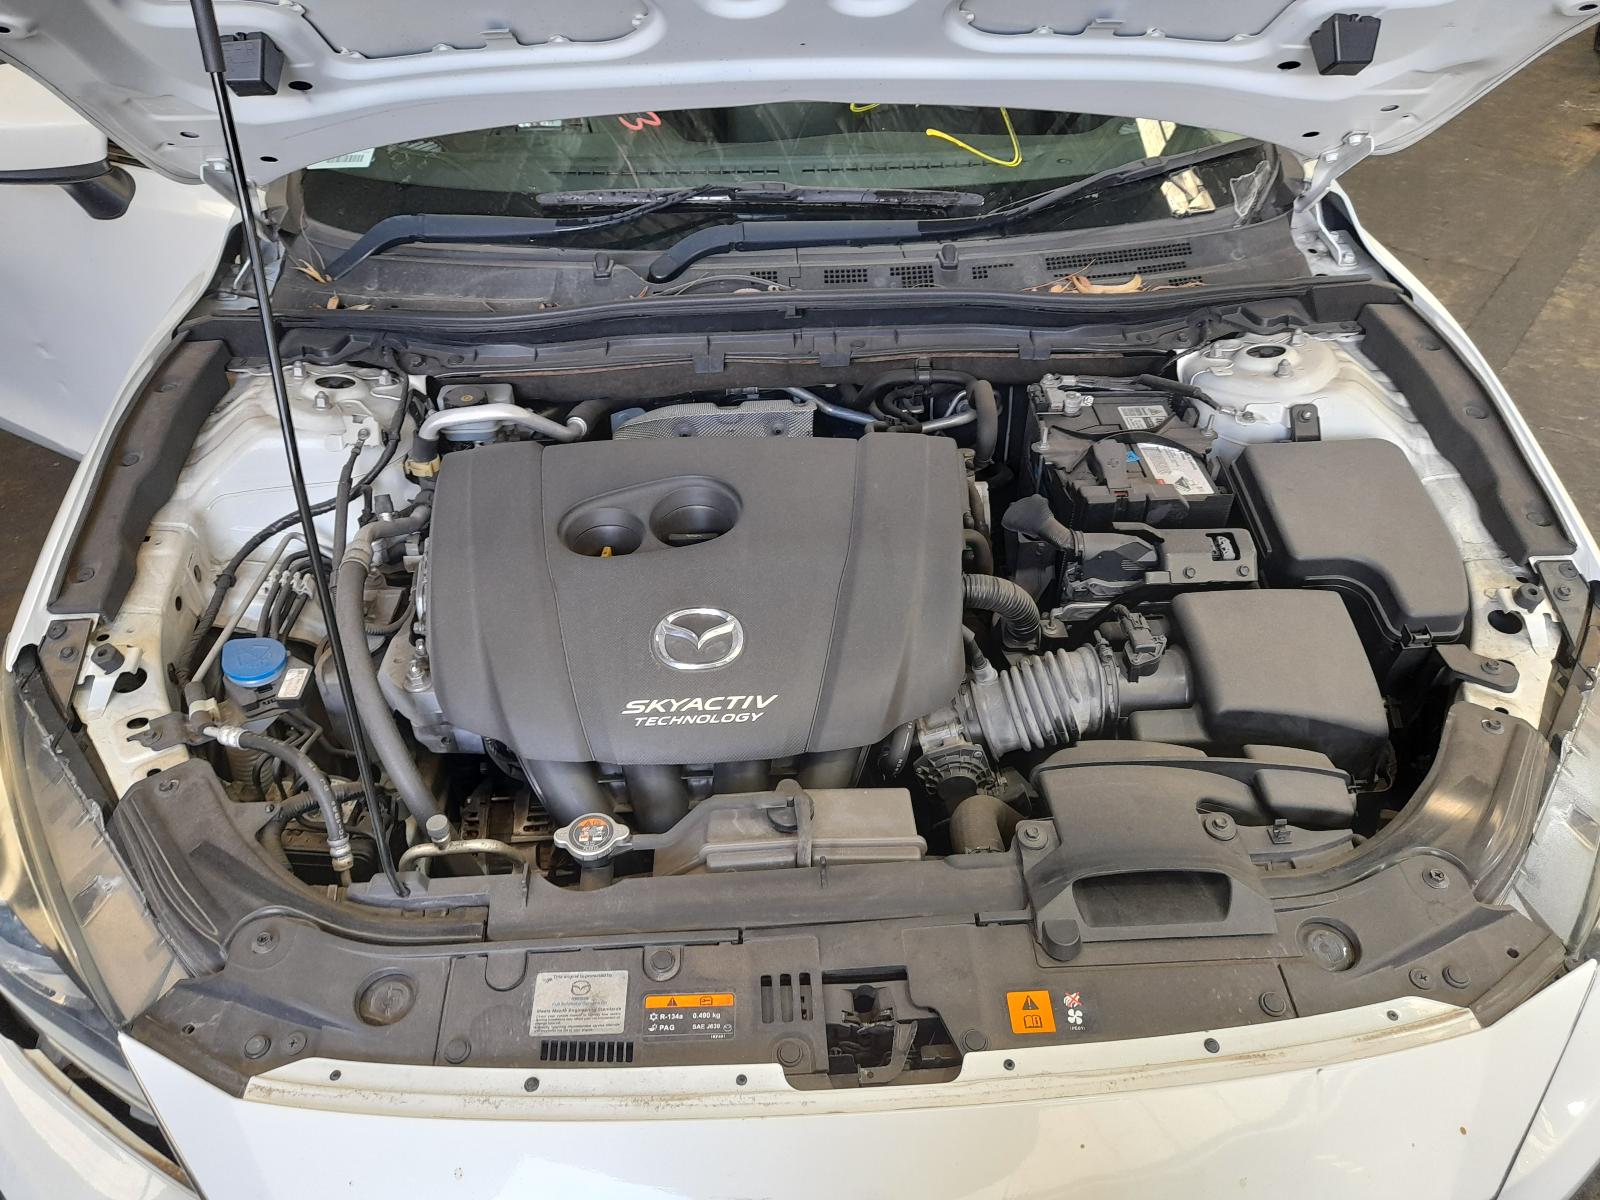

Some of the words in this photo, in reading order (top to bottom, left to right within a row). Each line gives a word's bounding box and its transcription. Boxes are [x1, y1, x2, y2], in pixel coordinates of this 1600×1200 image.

[621, 694, 779, 715] SKYACTIV
[634, 712, 764, 727] TECHNOLOGY
[712, 1012, 721, 1020] kg
